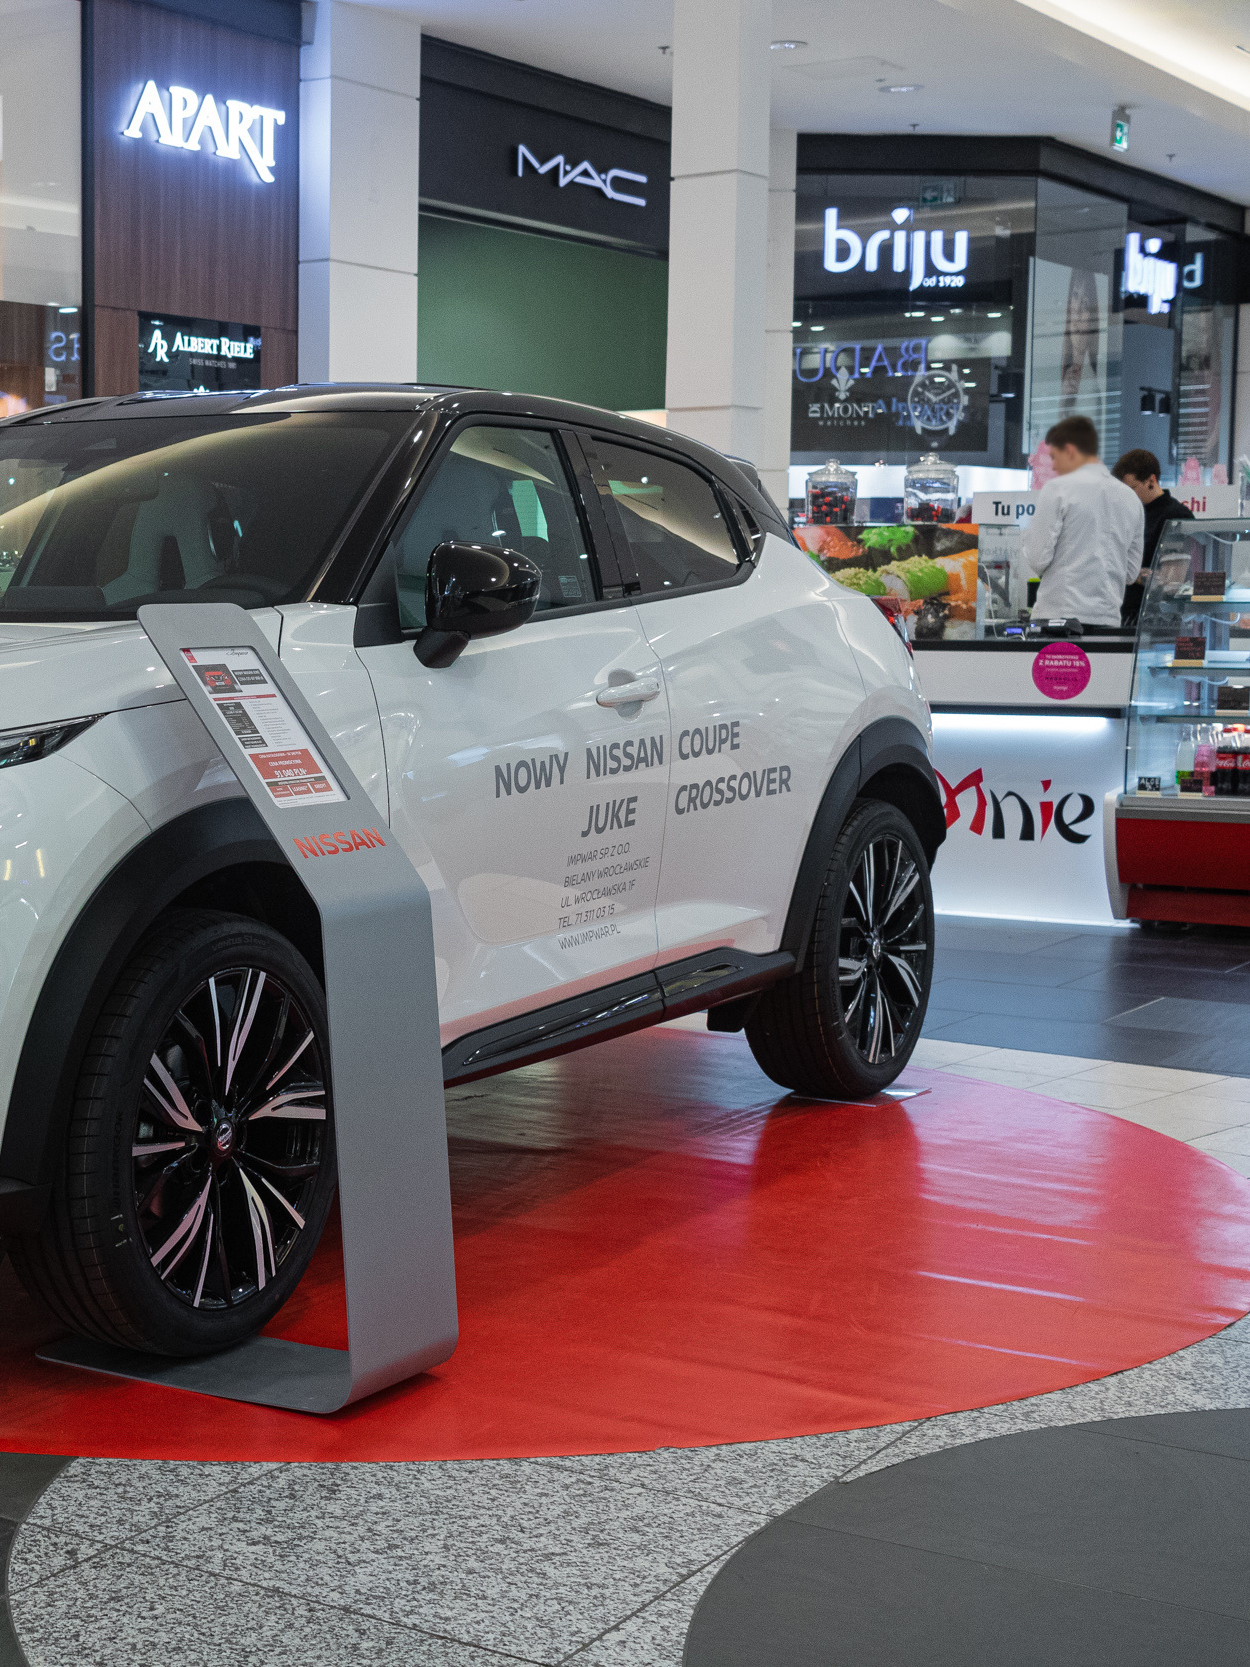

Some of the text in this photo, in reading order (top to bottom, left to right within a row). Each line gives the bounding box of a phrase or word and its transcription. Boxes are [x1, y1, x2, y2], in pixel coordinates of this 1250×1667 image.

[123, 80, 286, 183] APART
[823, 207, 969, 292] briju
[922, 275, 966, 288] od 1920
[171, 331, 220, 355] ALBERT
[220, 336, 254, 359] RIELE
[823, 402, 877, 418] MONT
[992, 501, 1011, 517] Tu
[494, 720, 740, 799] NOWY NISSAN COUPE
[581, 765, 792, 838] JUKE CROSSOVER
[292, 827, 387, 859] NISSAN
[566, 849, 599, 867] IMPWAR
[599, 847, 610, 860] SP.
[610, 845, 617, 857] Z
[563, 857, 650, 888] BIELANY WROCŁAWSKIE
[574, 881, 628, 905] WROCŁAWSKA
[574, 912, 584, 925] 71
[583, 909, 596, 923] 311
[596, 905, 607, 919] 03
[607, 903, 616, 916] 15
[558, 923, 622, 950] WWW.IMPWAR.PL
